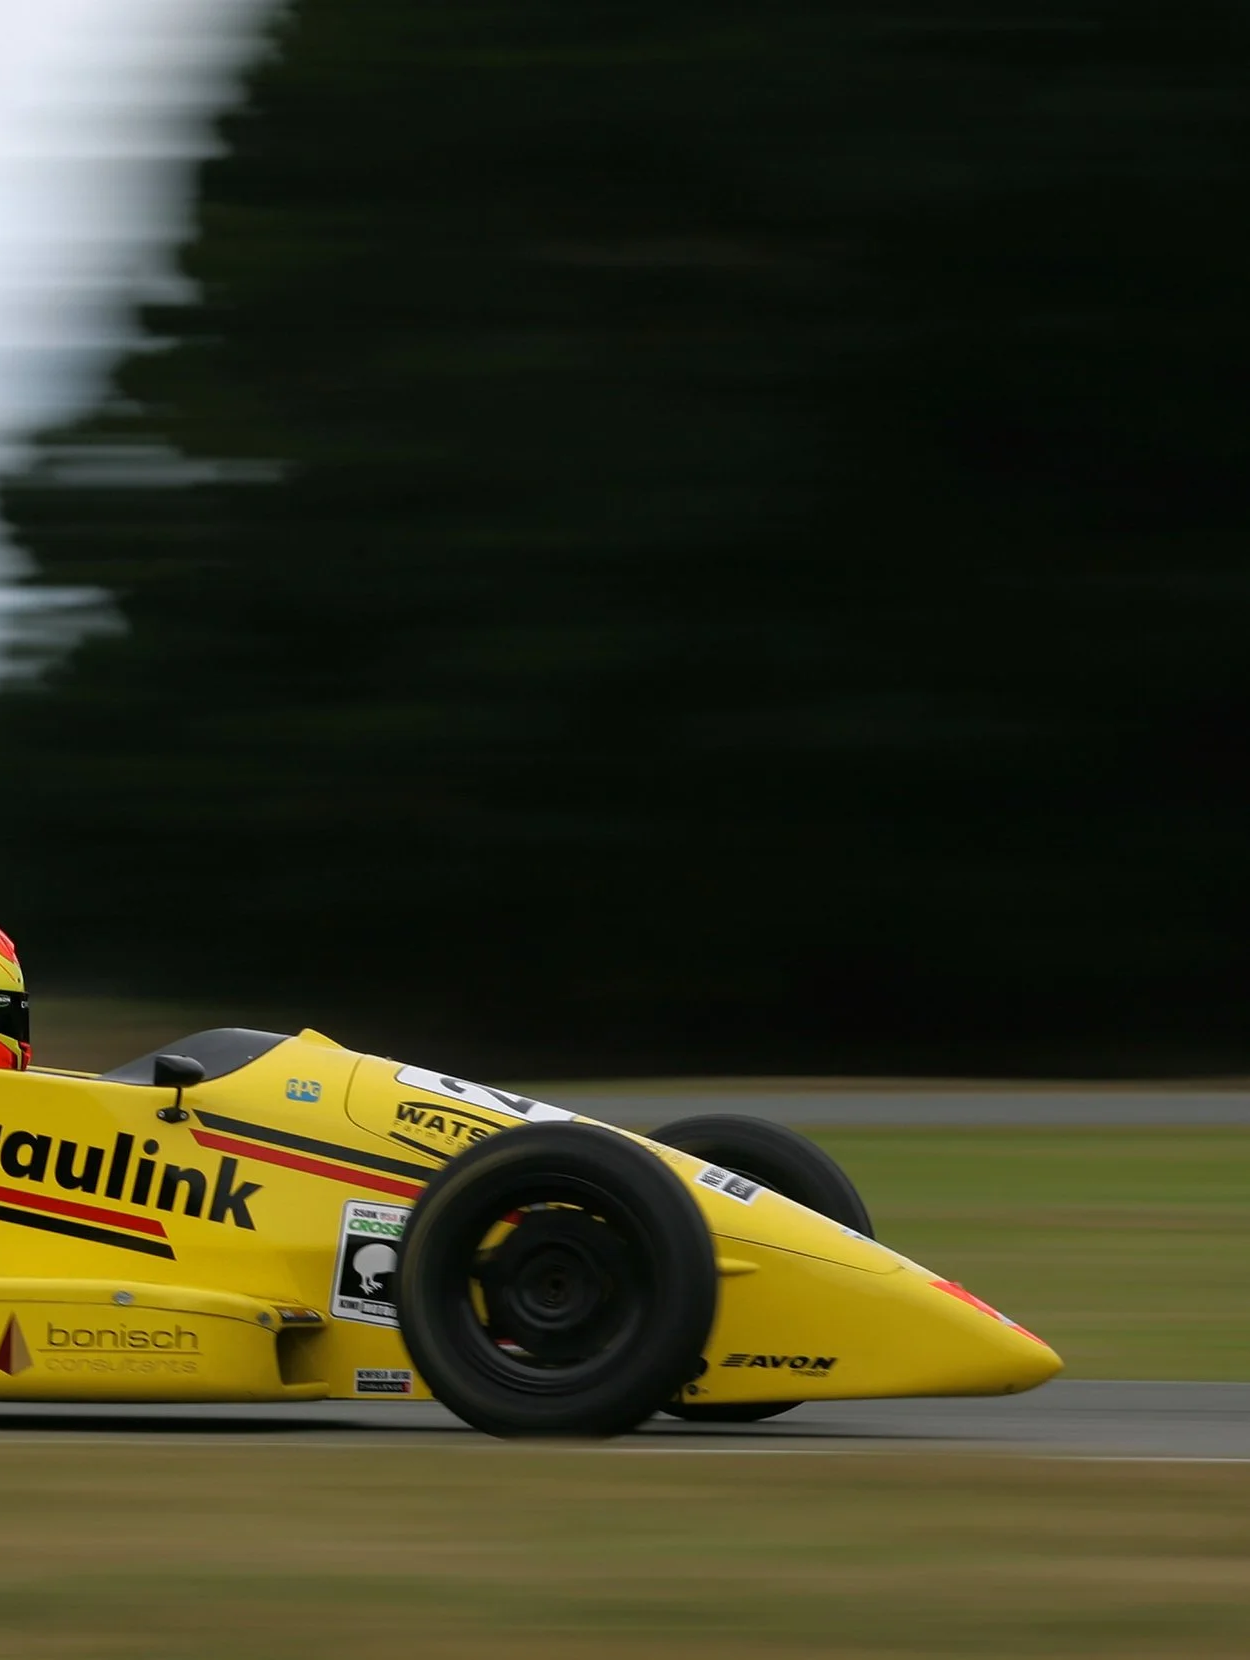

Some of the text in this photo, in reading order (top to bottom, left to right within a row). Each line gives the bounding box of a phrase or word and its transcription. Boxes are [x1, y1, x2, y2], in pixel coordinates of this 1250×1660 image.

[439, 1077, 537, 1115] 2
[395, 1103, 490, 1145] WATS
[46, 1321, 199, 1350] bonisch
[748, 1354, 838, 1370] AVON
